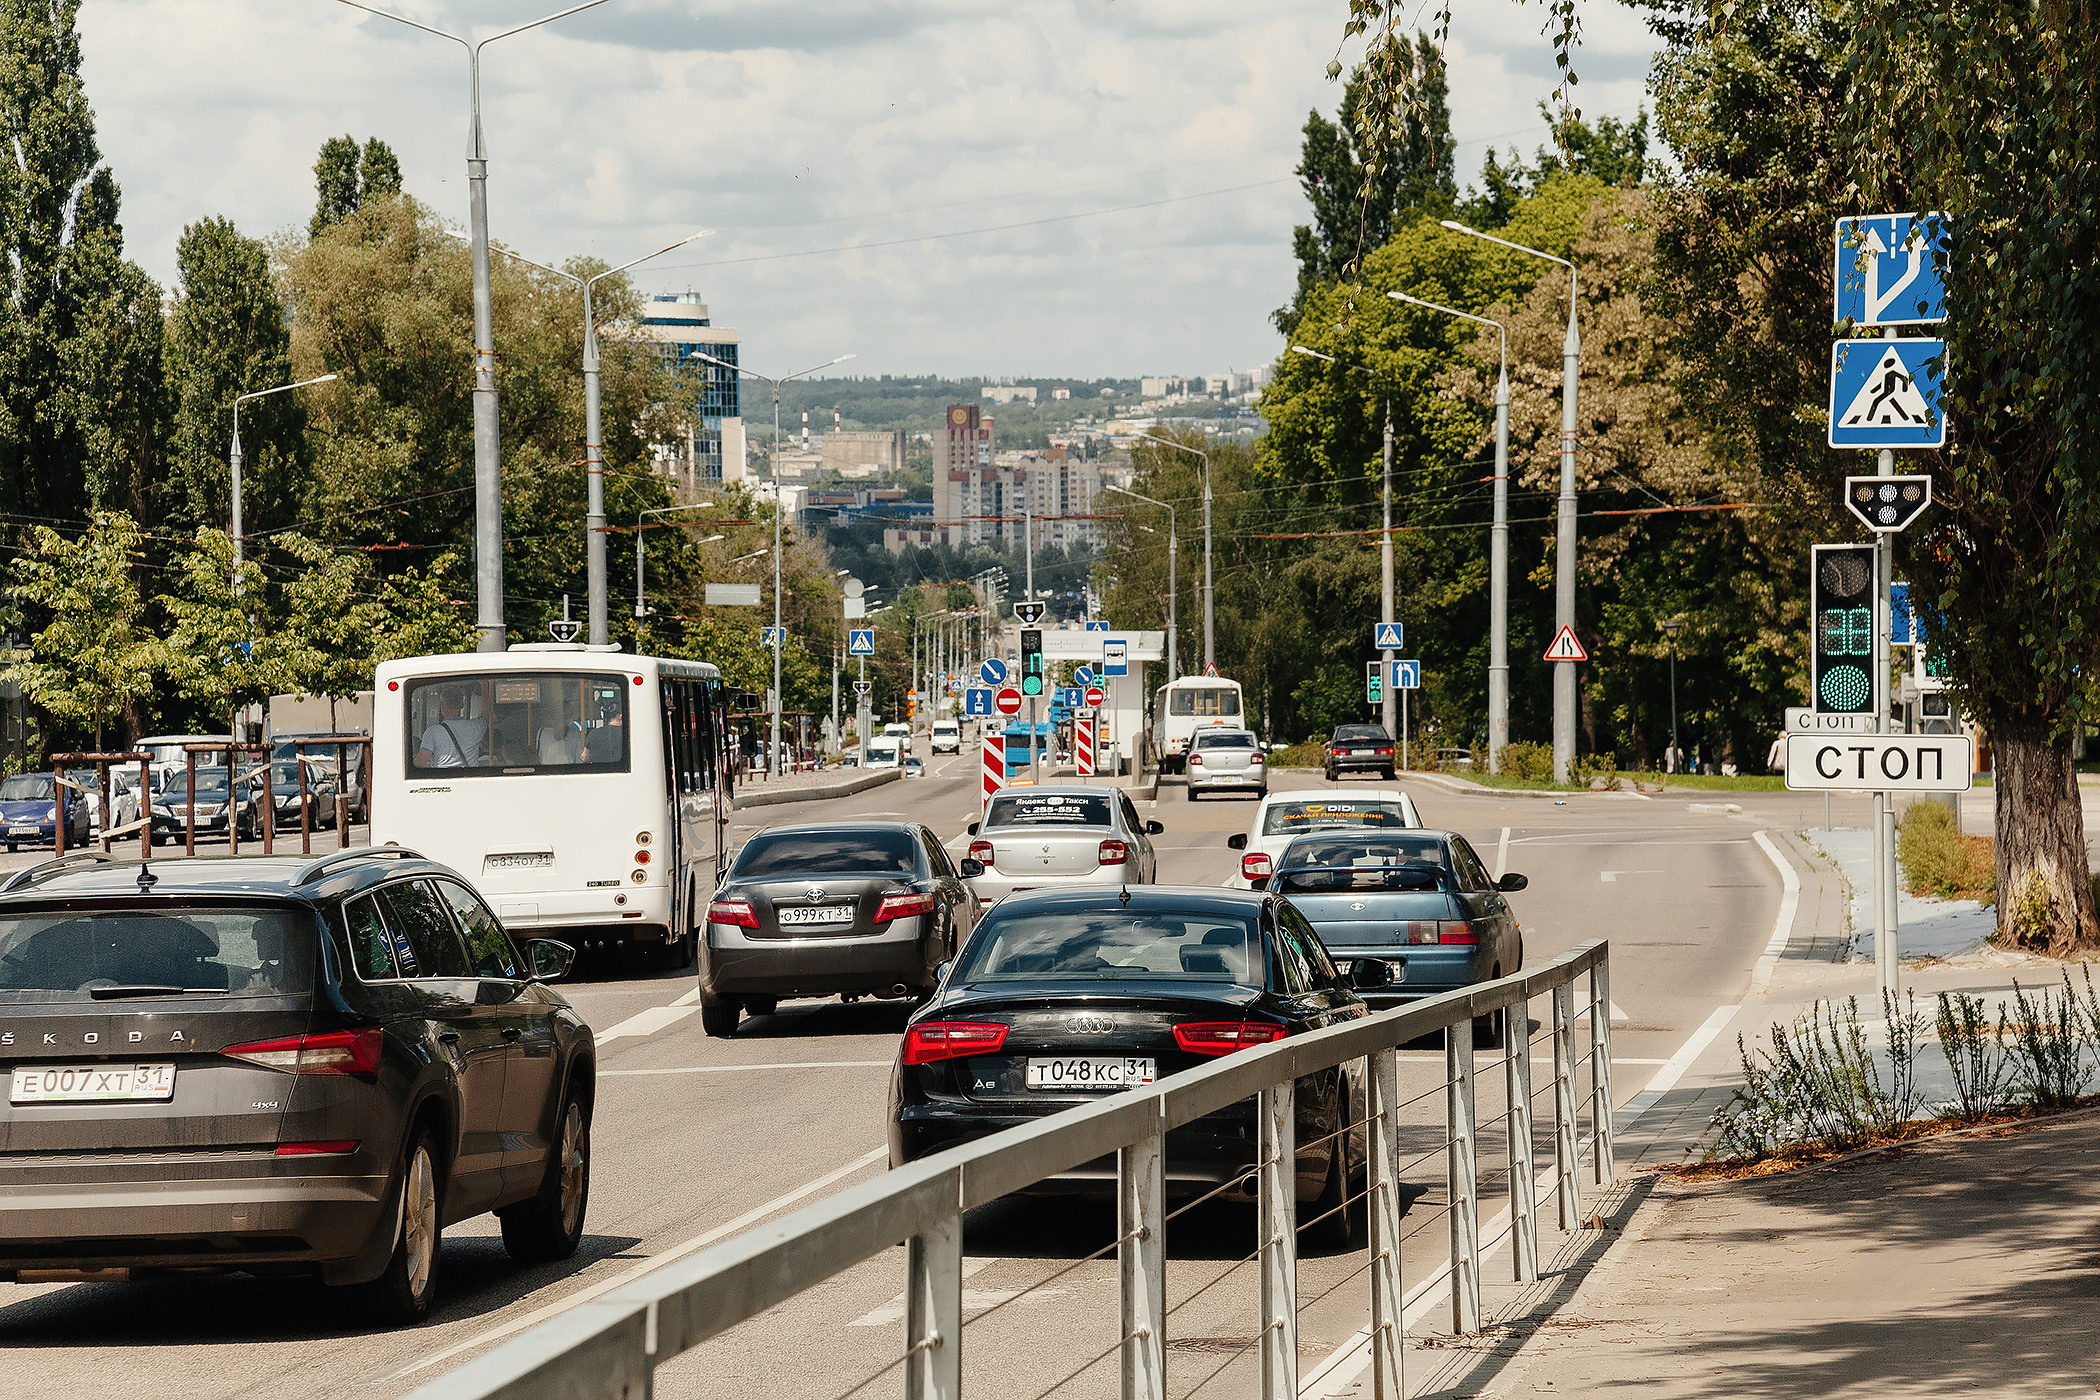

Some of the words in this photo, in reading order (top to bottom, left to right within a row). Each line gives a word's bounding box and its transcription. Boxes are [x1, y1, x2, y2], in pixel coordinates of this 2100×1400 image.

[1815, 745, 1943, 781] СТОП
[1064, 797, 1089, 805] Такси
[1283, 812, 1319, 821] СКАЧАЙ
[1, 1030, 185, 1046] ŠKODA
[1126, 1059, 1149, 1076] 31
[137, 1066, 164, 1084] 31
[134, 1083, 154, 1091] RUS
[973, 1078, 996, 1090] A6
